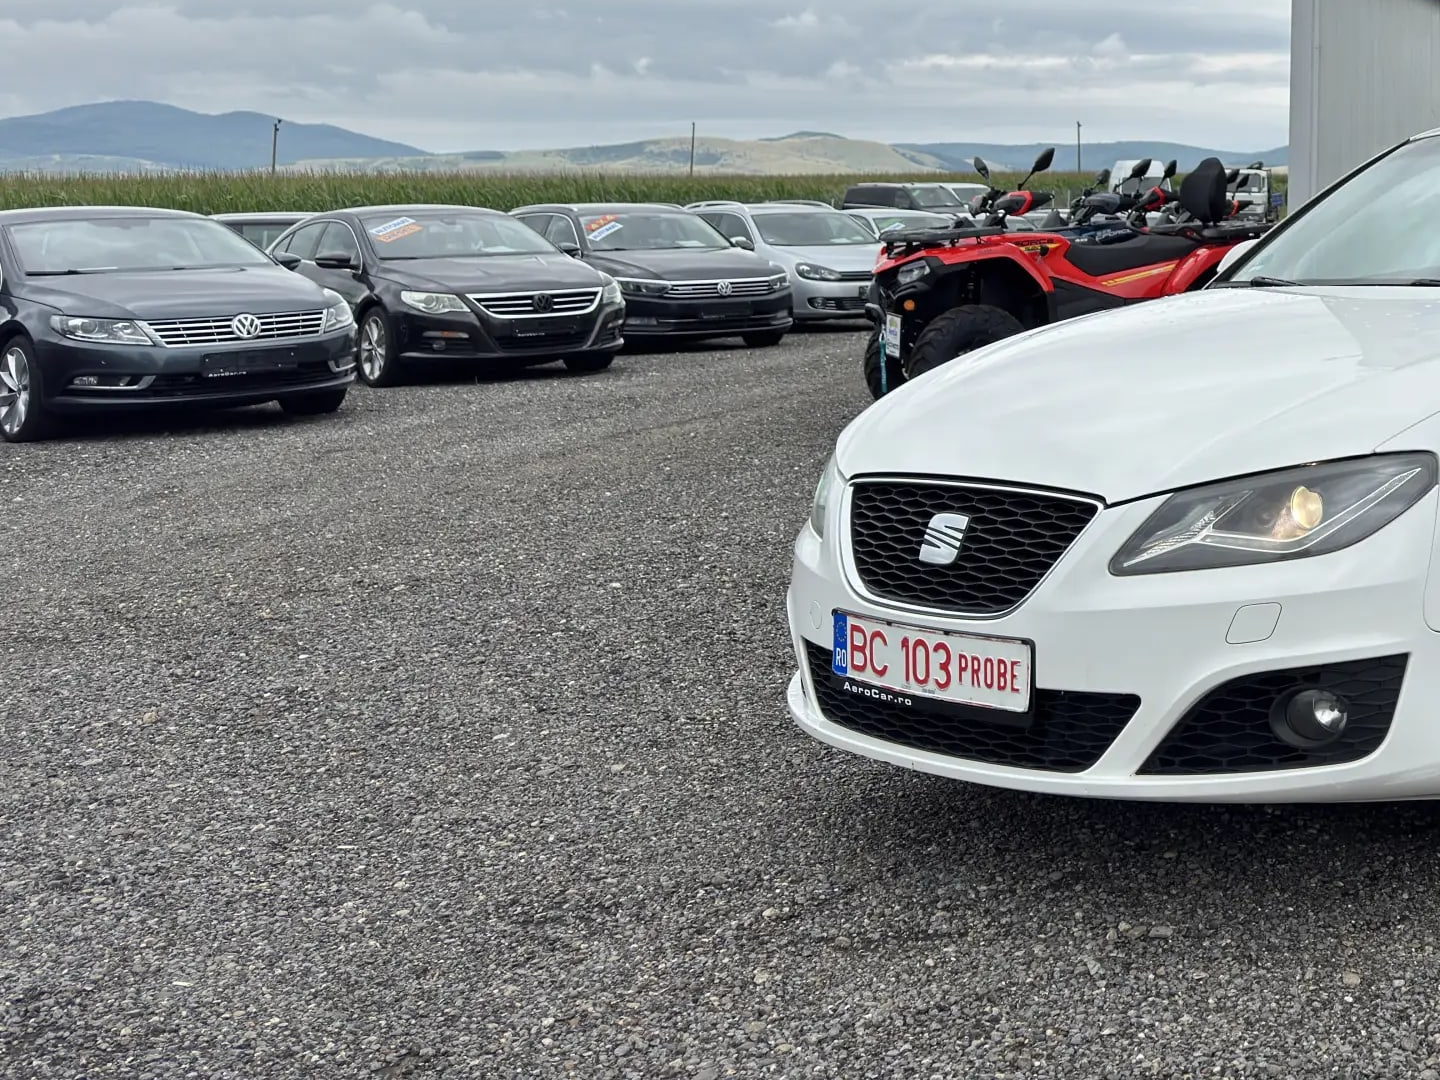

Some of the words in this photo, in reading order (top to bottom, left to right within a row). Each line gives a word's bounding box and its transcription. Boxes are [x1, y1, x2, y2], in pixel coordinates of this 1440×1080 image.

[835, 647, 847, 668] RO
[850, 624, 888, 678] BC
[901, 636, 952, 691] 103
[958, 652, 1022, 694] PROBE
[843, 681, 912, 706] AeroCar.ro
